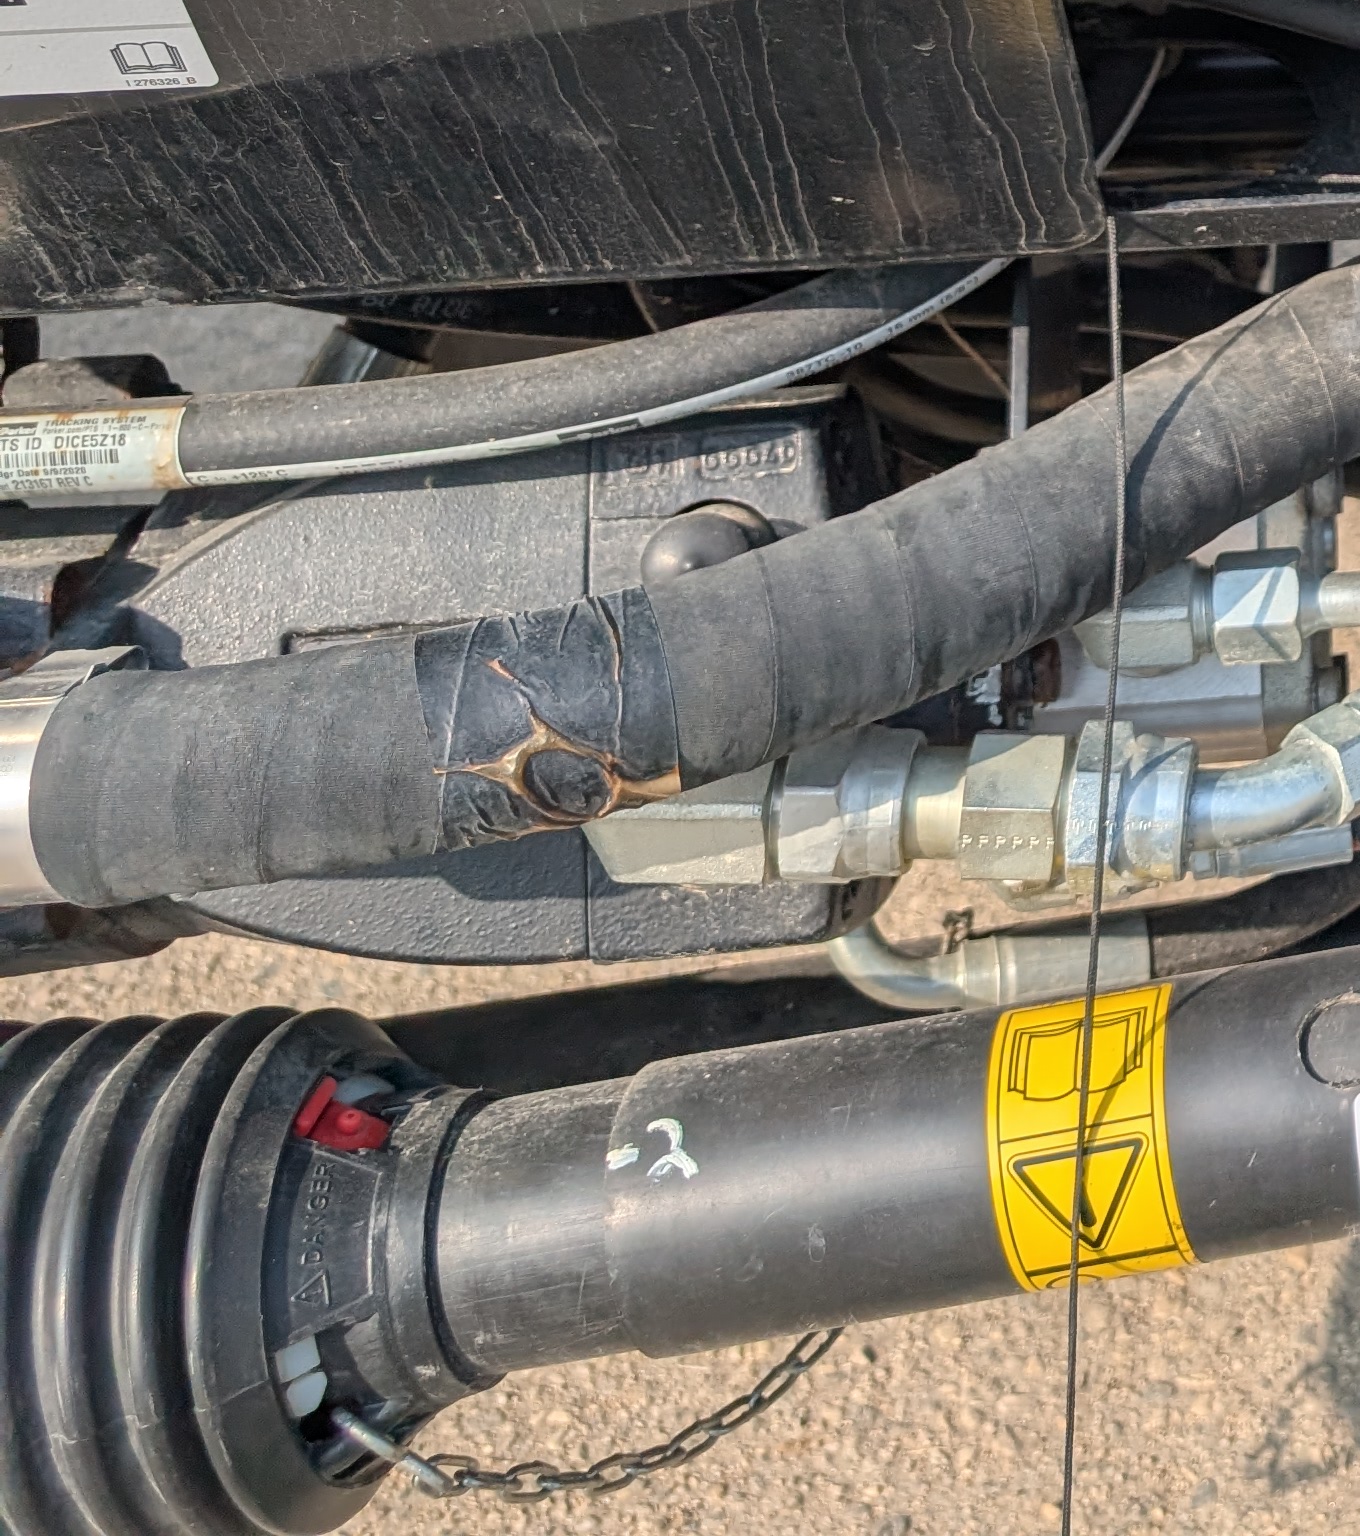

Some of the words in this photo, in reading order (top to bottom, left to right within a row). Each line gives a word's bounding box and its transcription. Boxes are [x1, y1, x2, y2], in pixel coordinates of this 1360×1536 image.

[45, 418, 98, 427] TRACKING
[103, 416, 146, 424] SYSTEM
[26, 437, 42, 450] ID
[54, 434, 126, 449] DICE5Z18
[18, 468, 39, 477] Date
[14, 479, 53, 490] 213167
[57, 476, 80, 487] REV
[84, 476, 93, 487] C
[300, 1161, 337, 1266] DANGER
